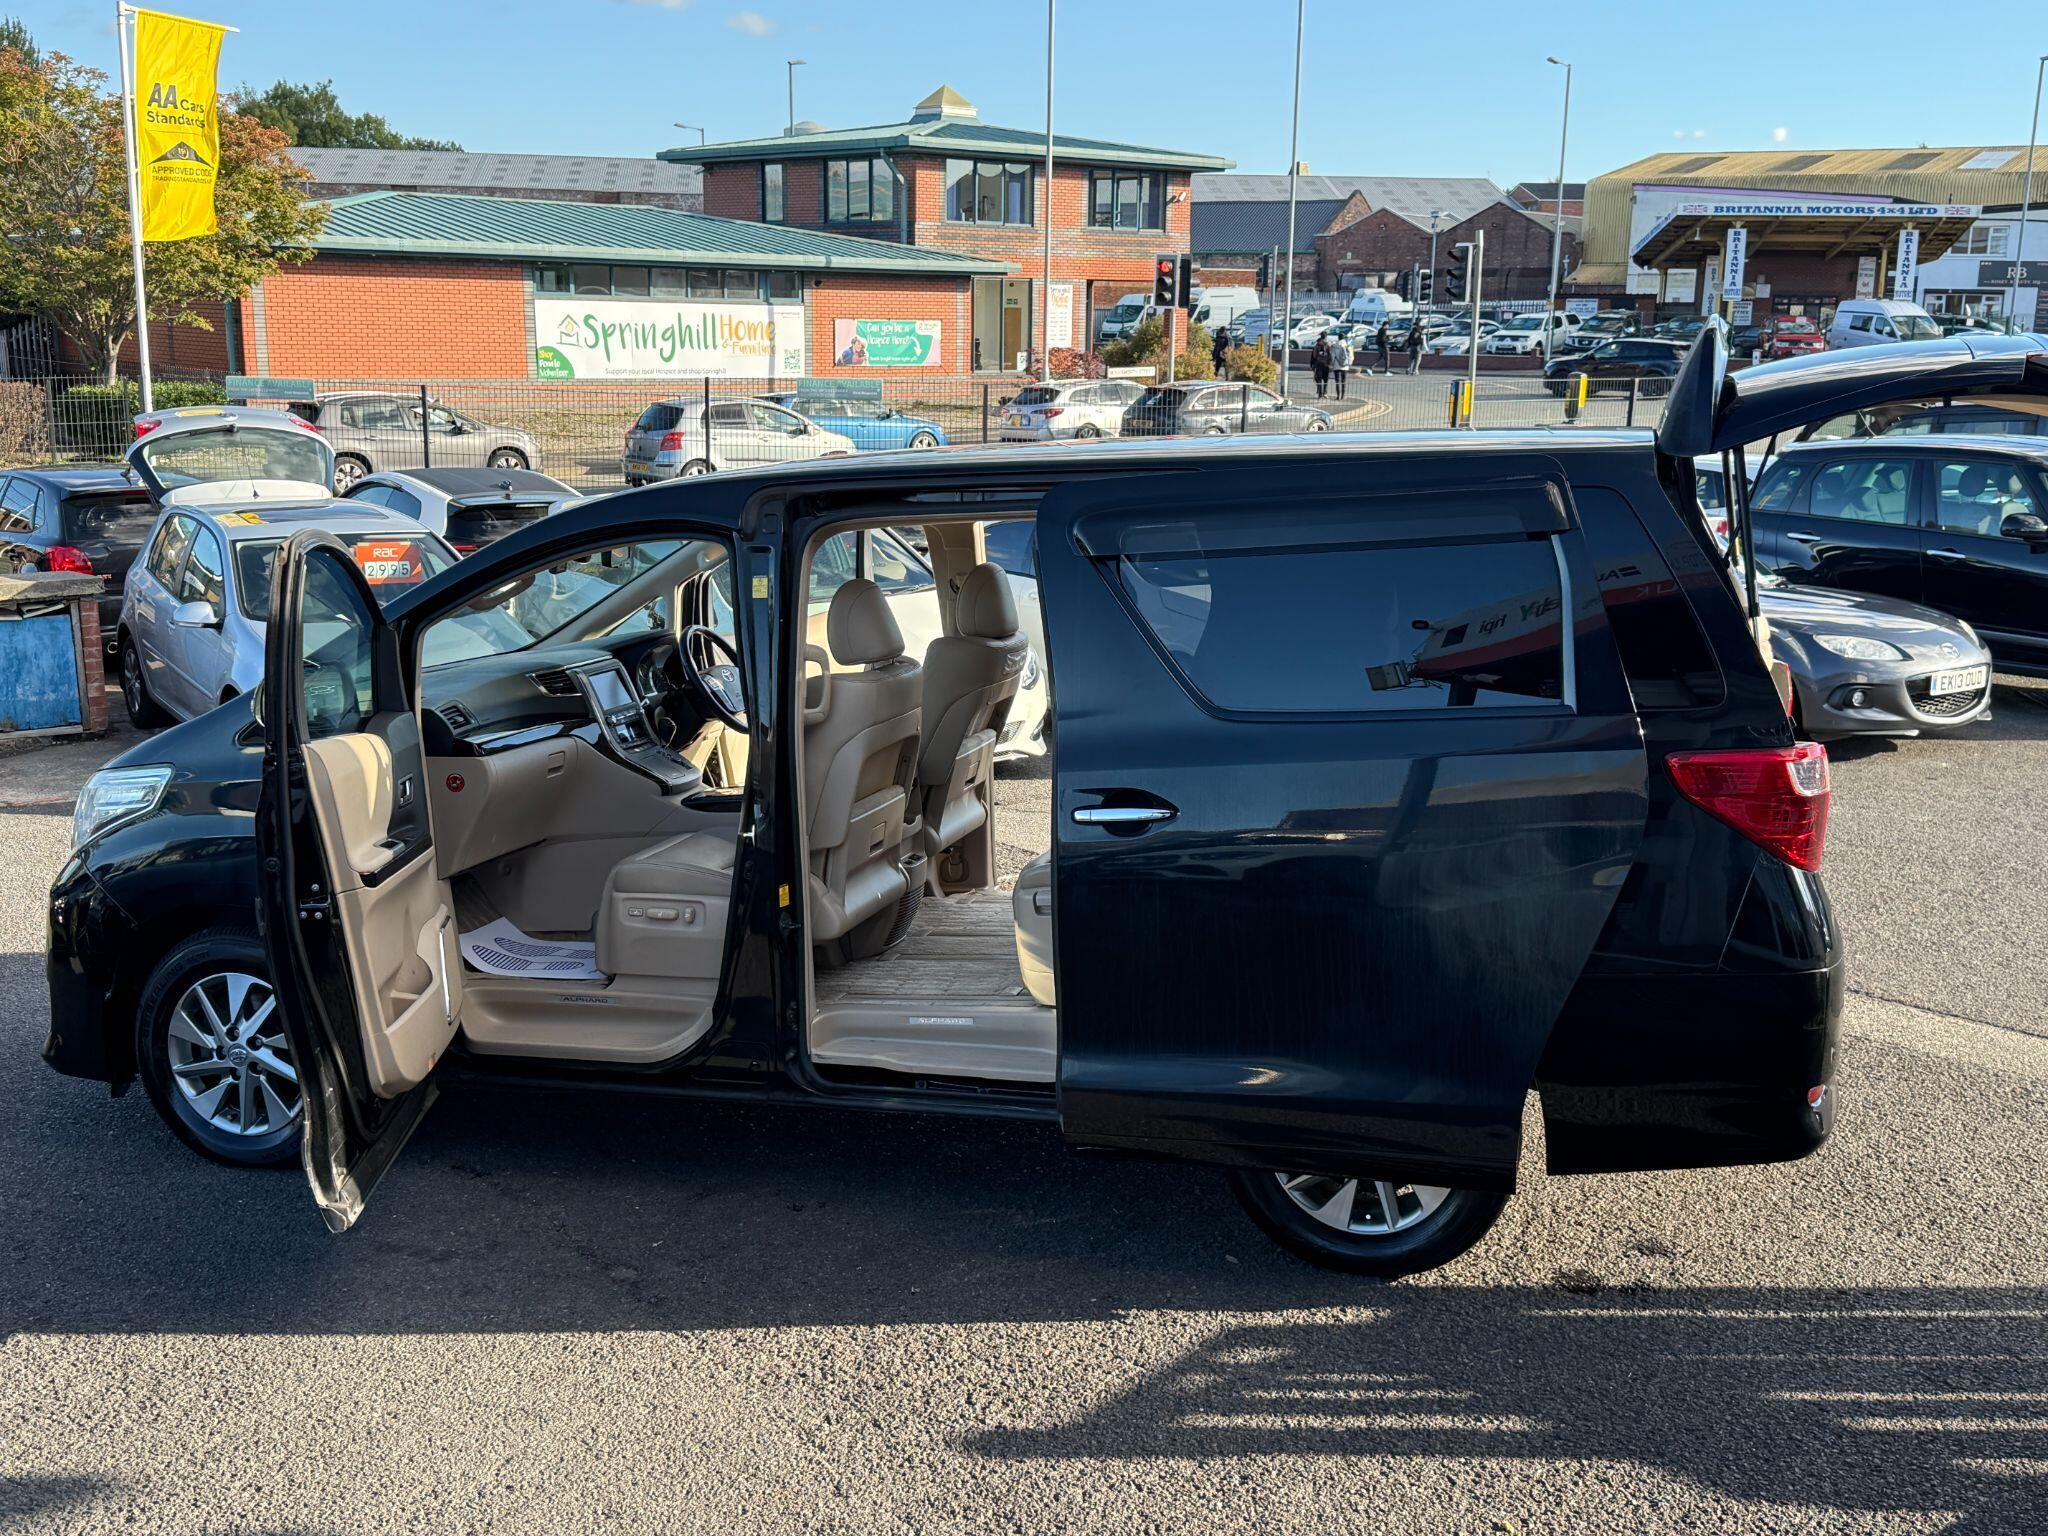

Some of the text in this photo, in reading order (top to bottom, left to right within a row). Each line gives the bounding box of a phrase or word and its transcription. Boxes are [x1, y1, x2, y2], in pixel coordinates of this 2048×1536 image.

[147, 82, 205, 113] AA Cars
[147, 110, 205, 128] Standards
[152, 166, 213, 177] APPROVED CODE
[1713, 206, 1801, 214] BRITANNIA
[1806, 206, 1875, 215] MOTORS
[1907, 207, 1938, 215] LTD
[1729, 230, 1741, 287] BRITANNIA
[1899, 231, 1914, 288] BRITANNIA
[583, 312, 776, 363] Springhill Home
[539, 369, 569, 377] Volunteer
[605, 367, 727, 377] Support your local Hospice and shop Springhill
[228, 378, 311, 388] FINANCE AVAILABLE
[799, 379, 881, 388] FINANCE AVAILABLE
[367, 563, 409, 577] 2995
[1940, 674, 1964, 691] EK13
